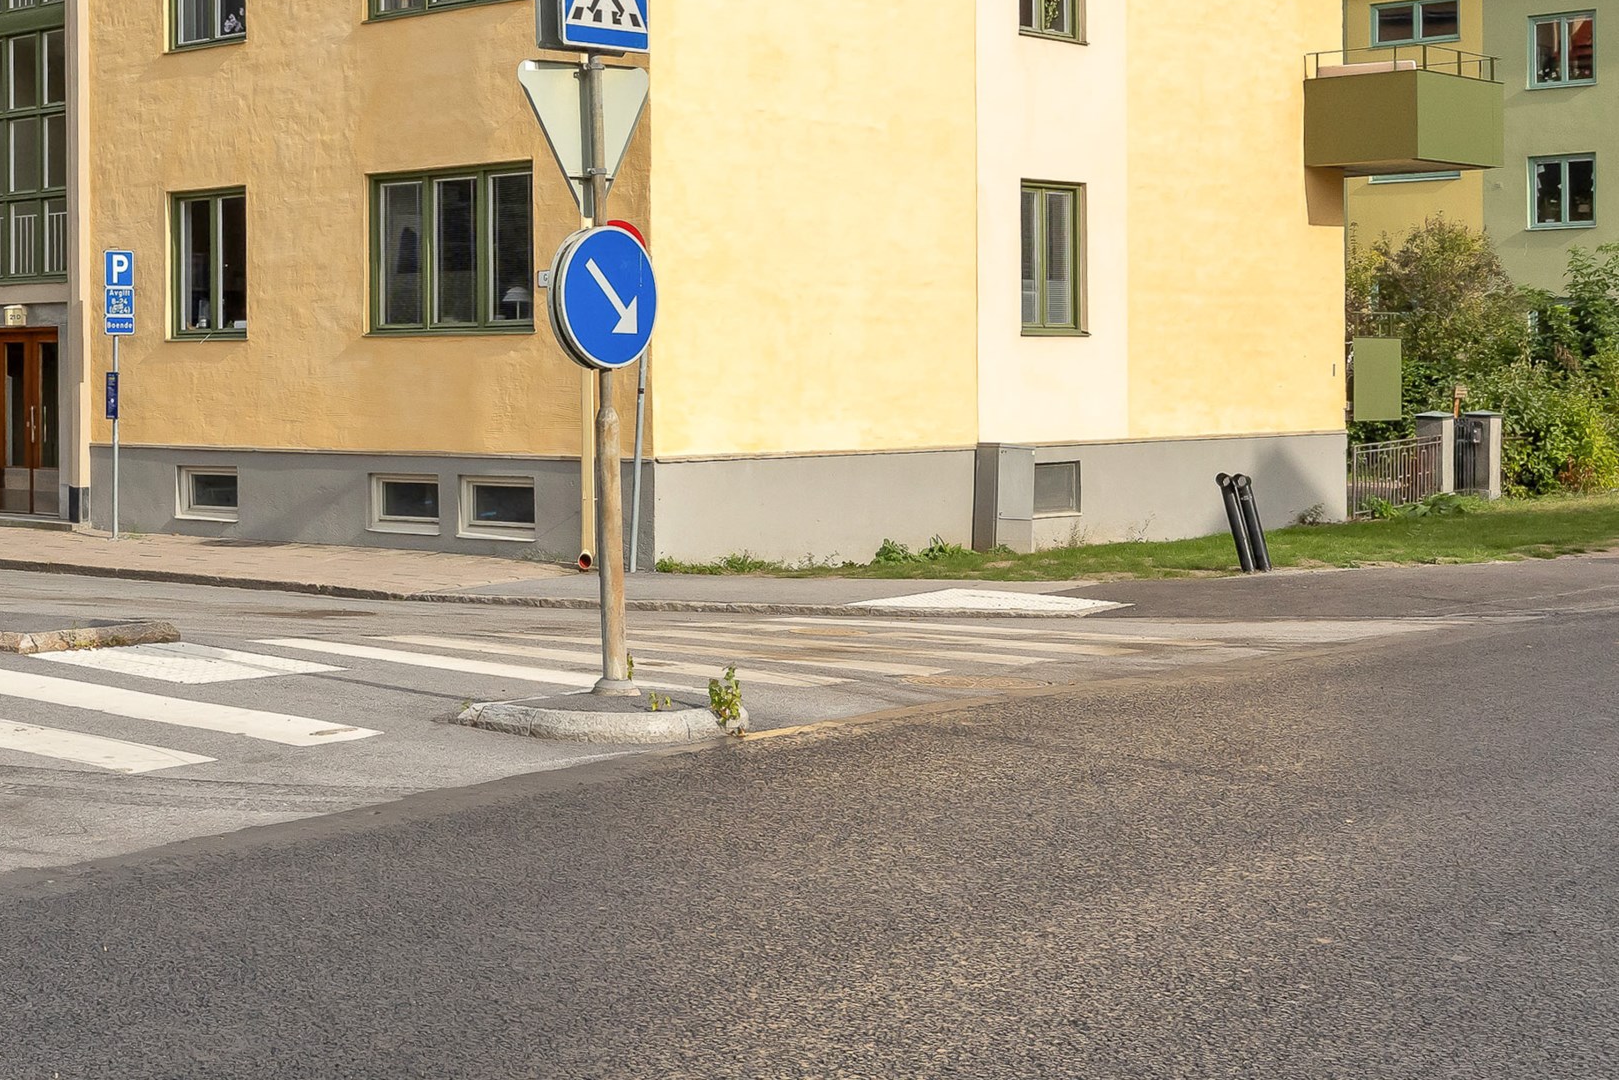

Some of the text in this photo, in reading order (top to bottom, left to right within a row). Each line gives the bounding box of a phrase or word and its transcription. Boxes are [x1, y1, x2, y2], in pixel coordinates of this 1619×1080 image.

[112, 254, 129, 284] P
[109, 290, 131, 298] Avgift
[107, 321, 133, 329] Boende
